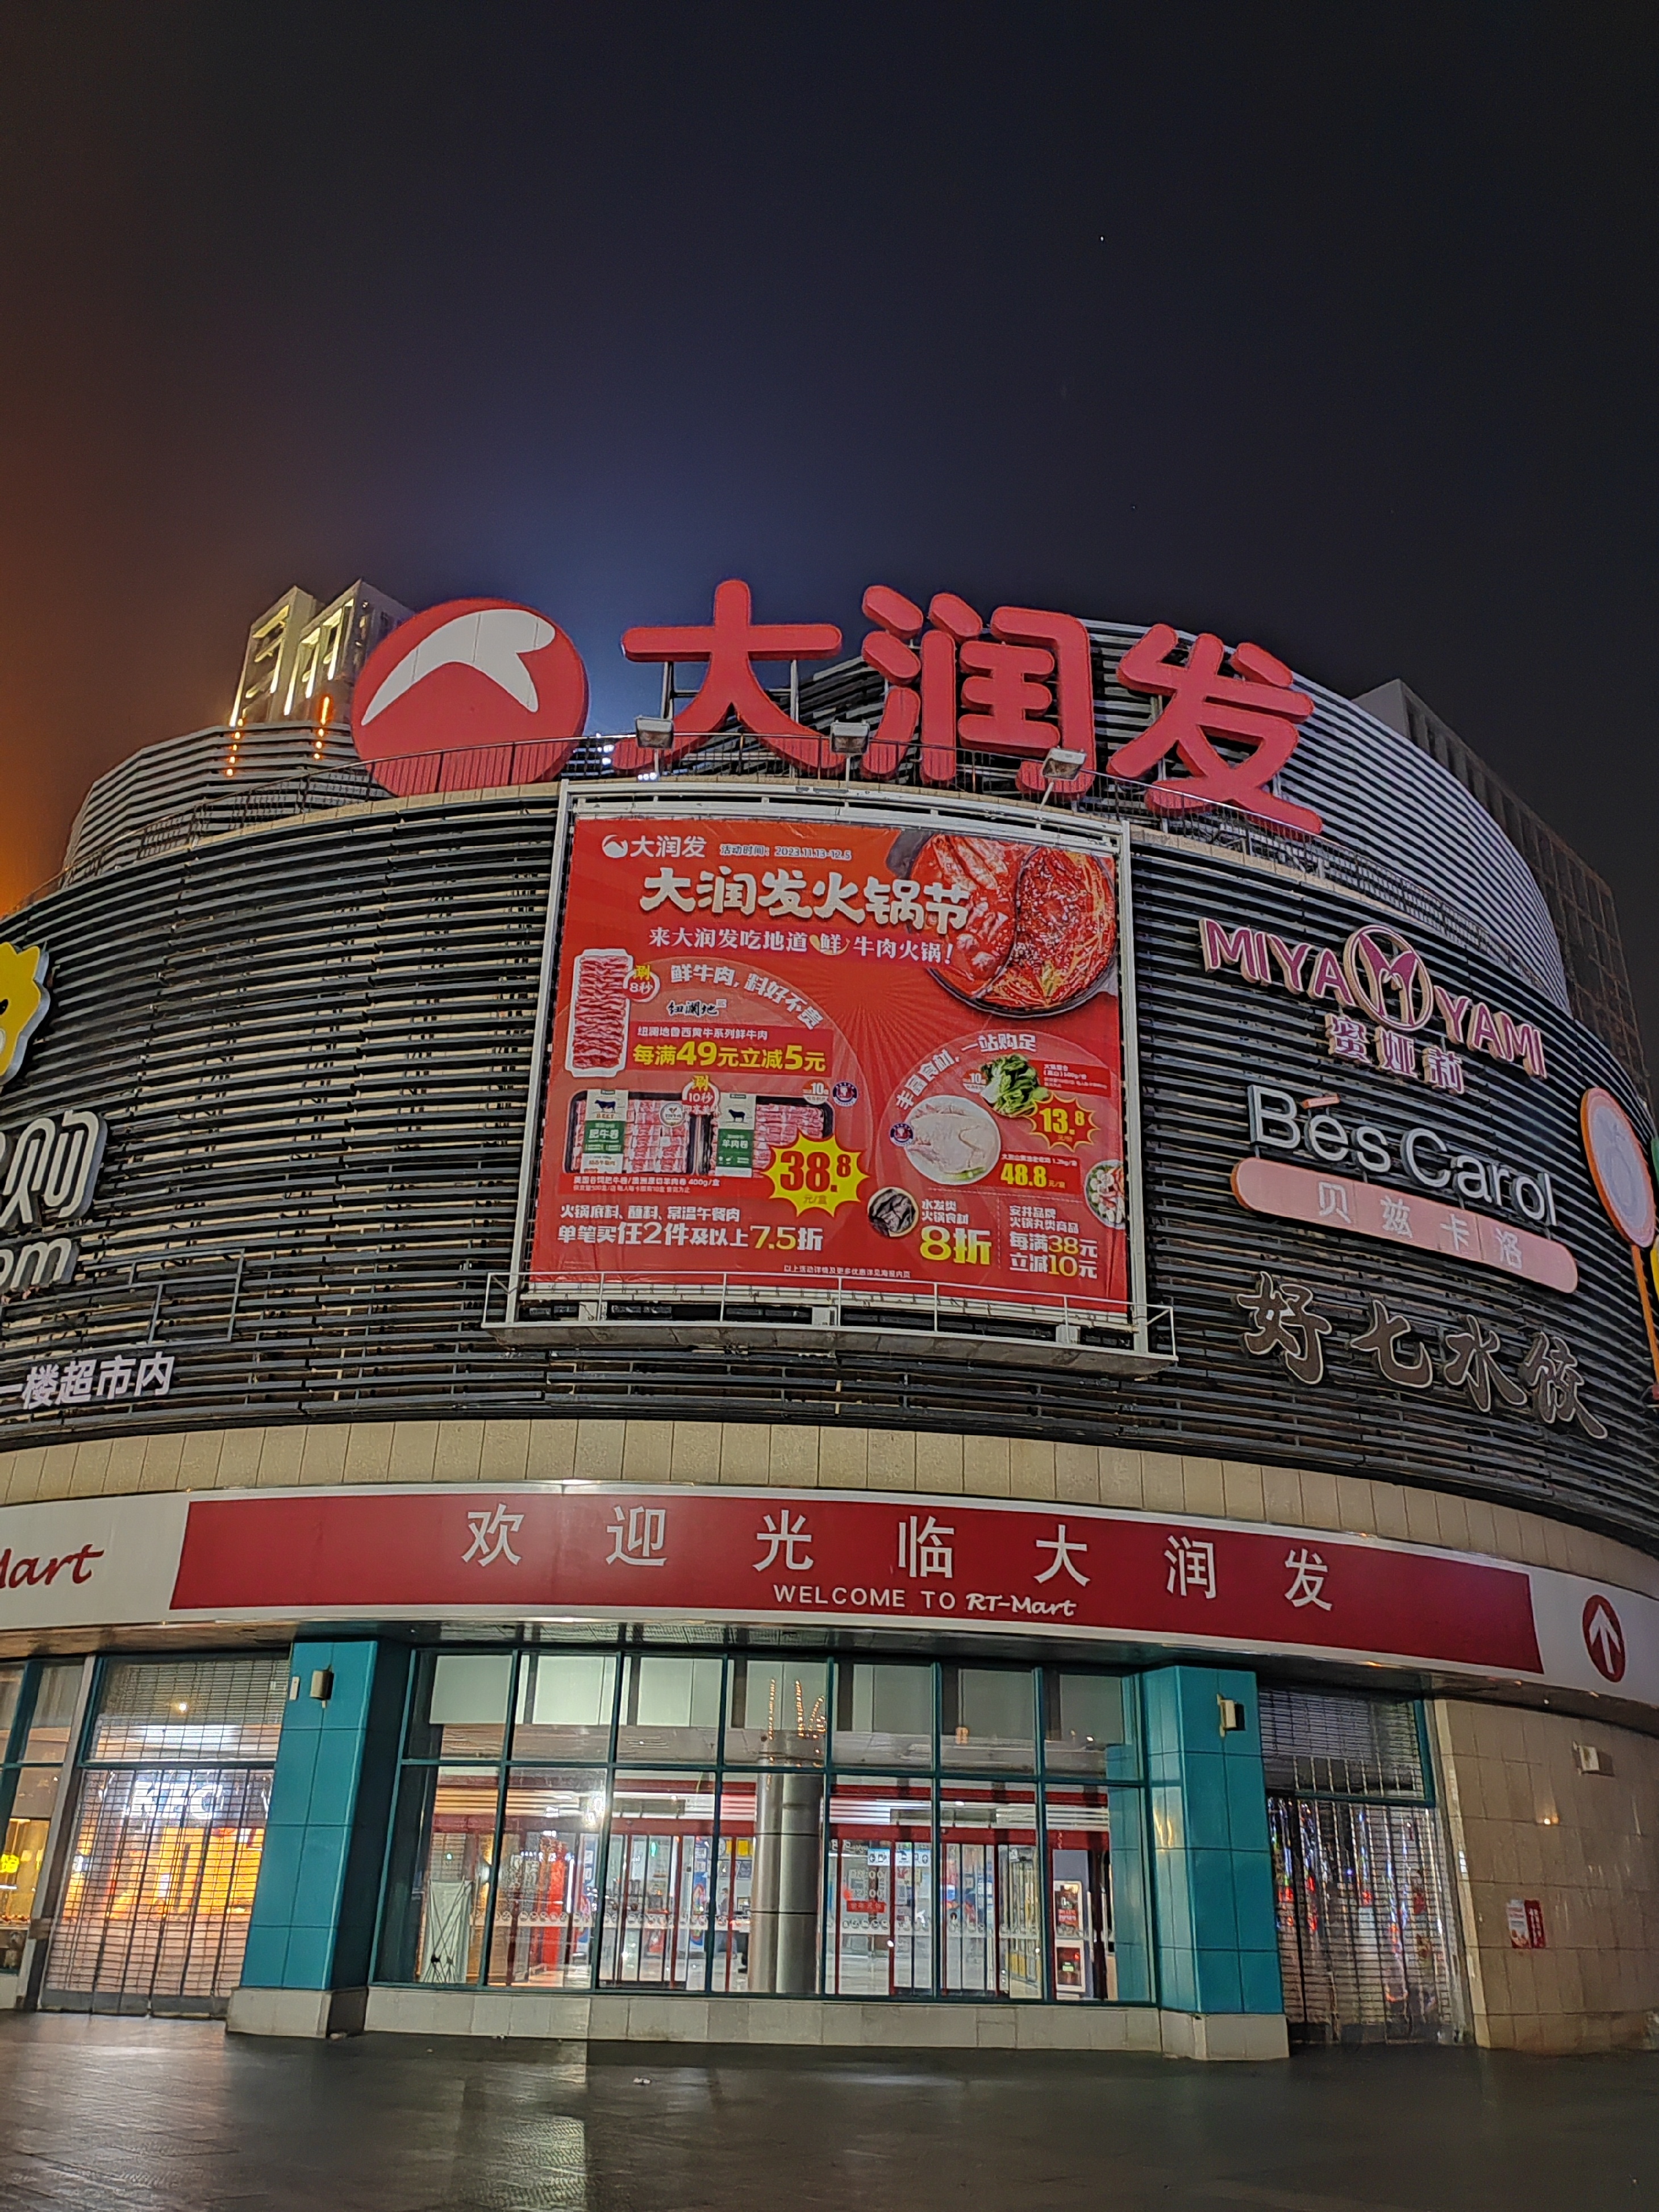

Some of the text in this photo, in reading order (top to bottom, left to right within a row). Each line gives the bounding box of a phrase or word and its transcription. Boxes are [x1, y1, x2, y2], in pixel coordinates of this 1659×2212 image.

[612, 579, 1322, 834] 大润发
[630, 835, 707, 858] 大润发
[640, 867, 969, 935] 大润发火锅节
[1199, 918, 1357, 1008] MIYA
[630, 983, 653, 994] 8秒
[1434, 985, 1549, 1080] YAMI
[633, 1041, 827, 1072] 每满49元立减5元
[689, 1093, 714, 1104] 10秒
[1039, 1107, 1085, 1135] 13.8
[780, 1151, 852, 1193] 38.8
[1000, 1163, 1047, 1189] 48.8
[922, 1211, 969, 1225] 火锅食材
[557, 1222, 824, 1251] 单笔买任2件及以上7.5折
[920, 1225, 992, 1265] 8折
[1009, 1231, 1098, 1259] 每满38元
[1009, 1252, 1098, 1279] 立减10元
[461, 1503, 1333, 1611] 欢迎光临大润发
[773, 1584, 1077, 1617] WELCOME TO RT-Mart
